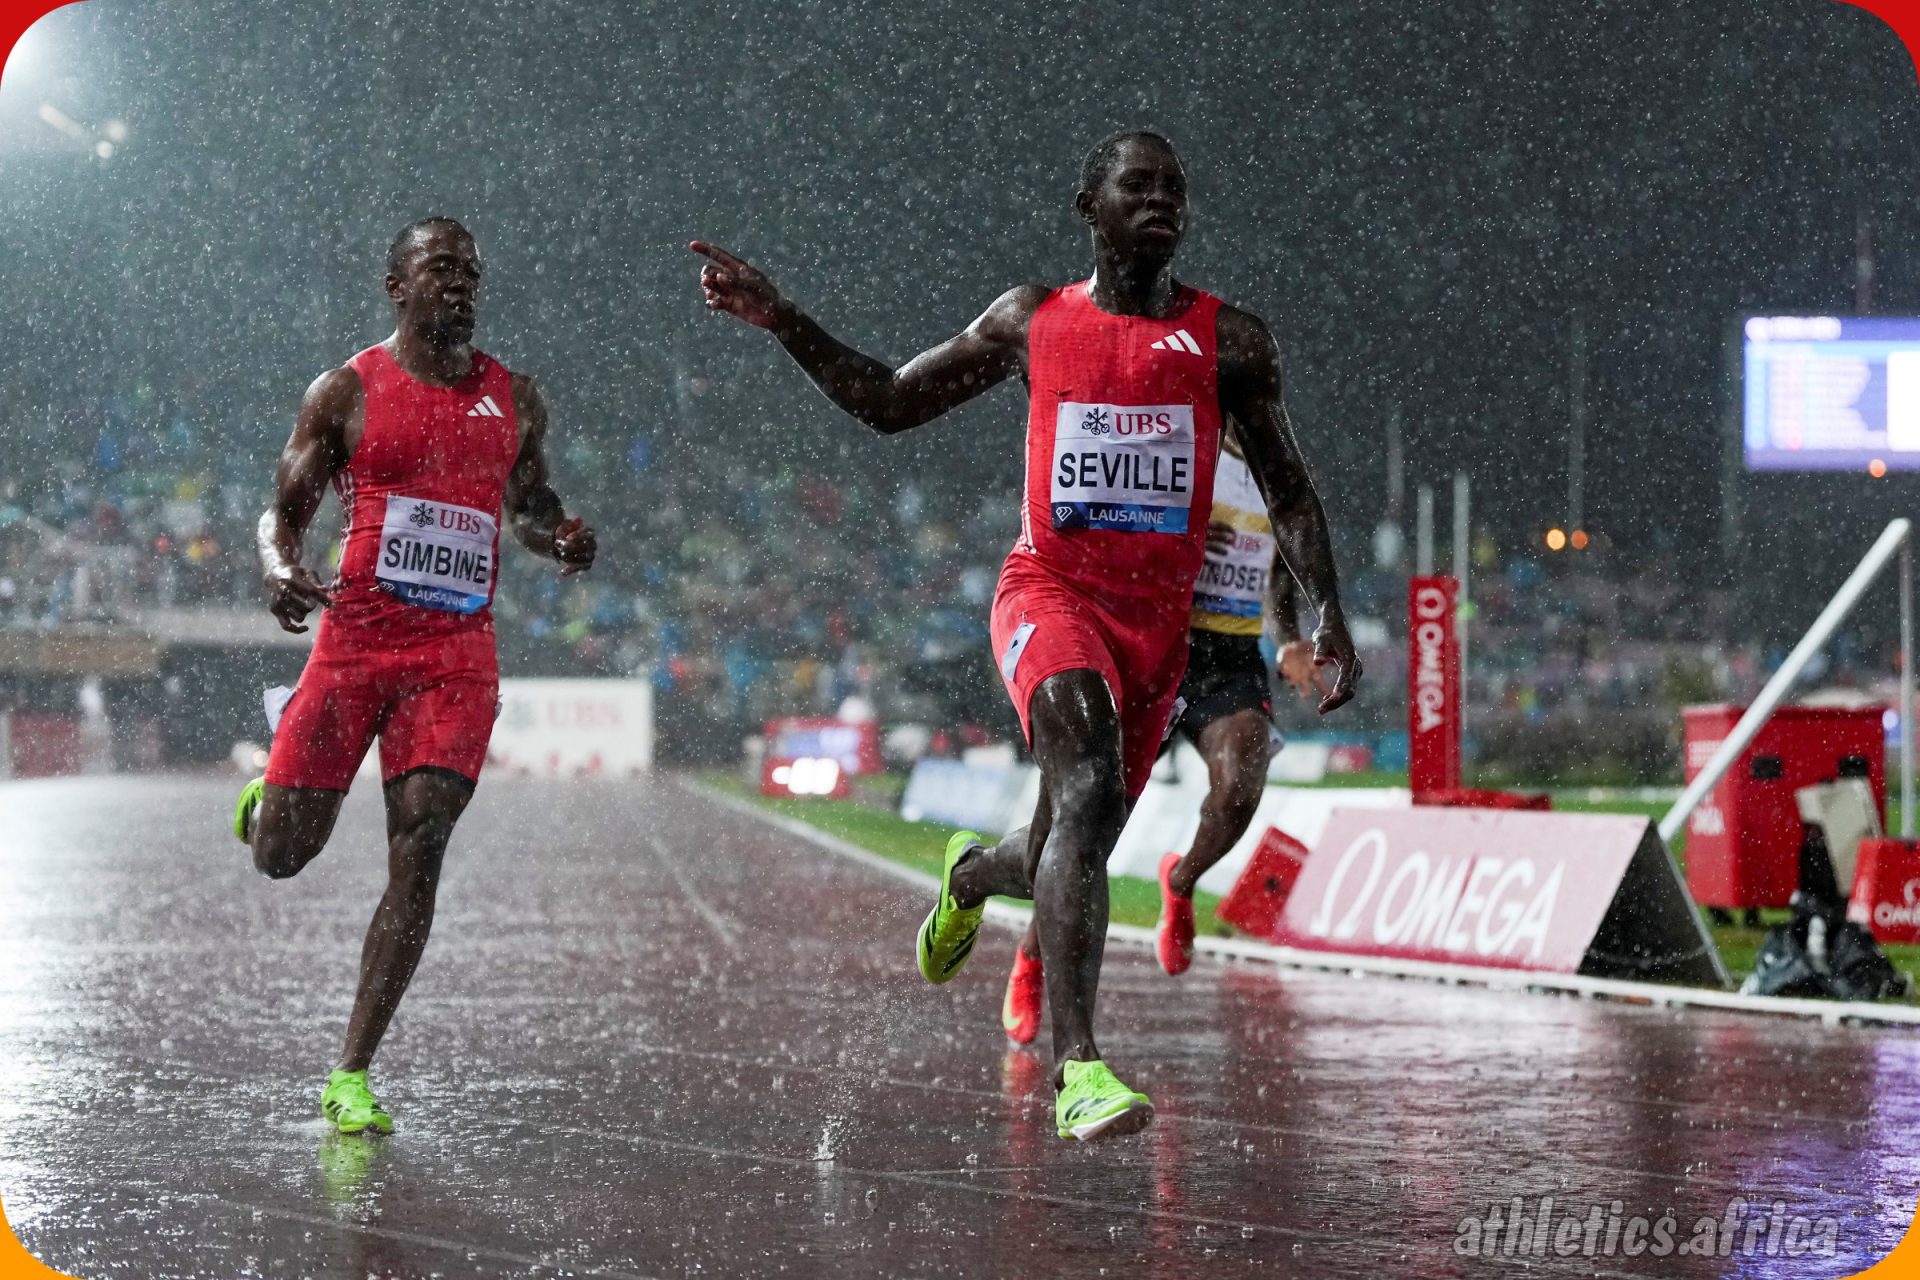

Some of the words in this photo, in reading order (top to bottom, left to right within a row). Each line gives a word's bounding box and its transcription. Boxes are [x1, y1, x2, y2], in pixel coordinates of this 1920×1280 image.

[1114, 412, 1172, 436] UBS
[1057, 452, 1188, 493] SEVILLE
[439, 508, 482, 535] UBS
[1089, 508, 1165, 525] LAUSANNE
[384, 538, 488, 585] SIMBINE
[408, 588, 470, 608] LAUSANNE
[1416, 622, 1445, 733] OMEGA
[1373, 851, 1566, 958] OMEGA
